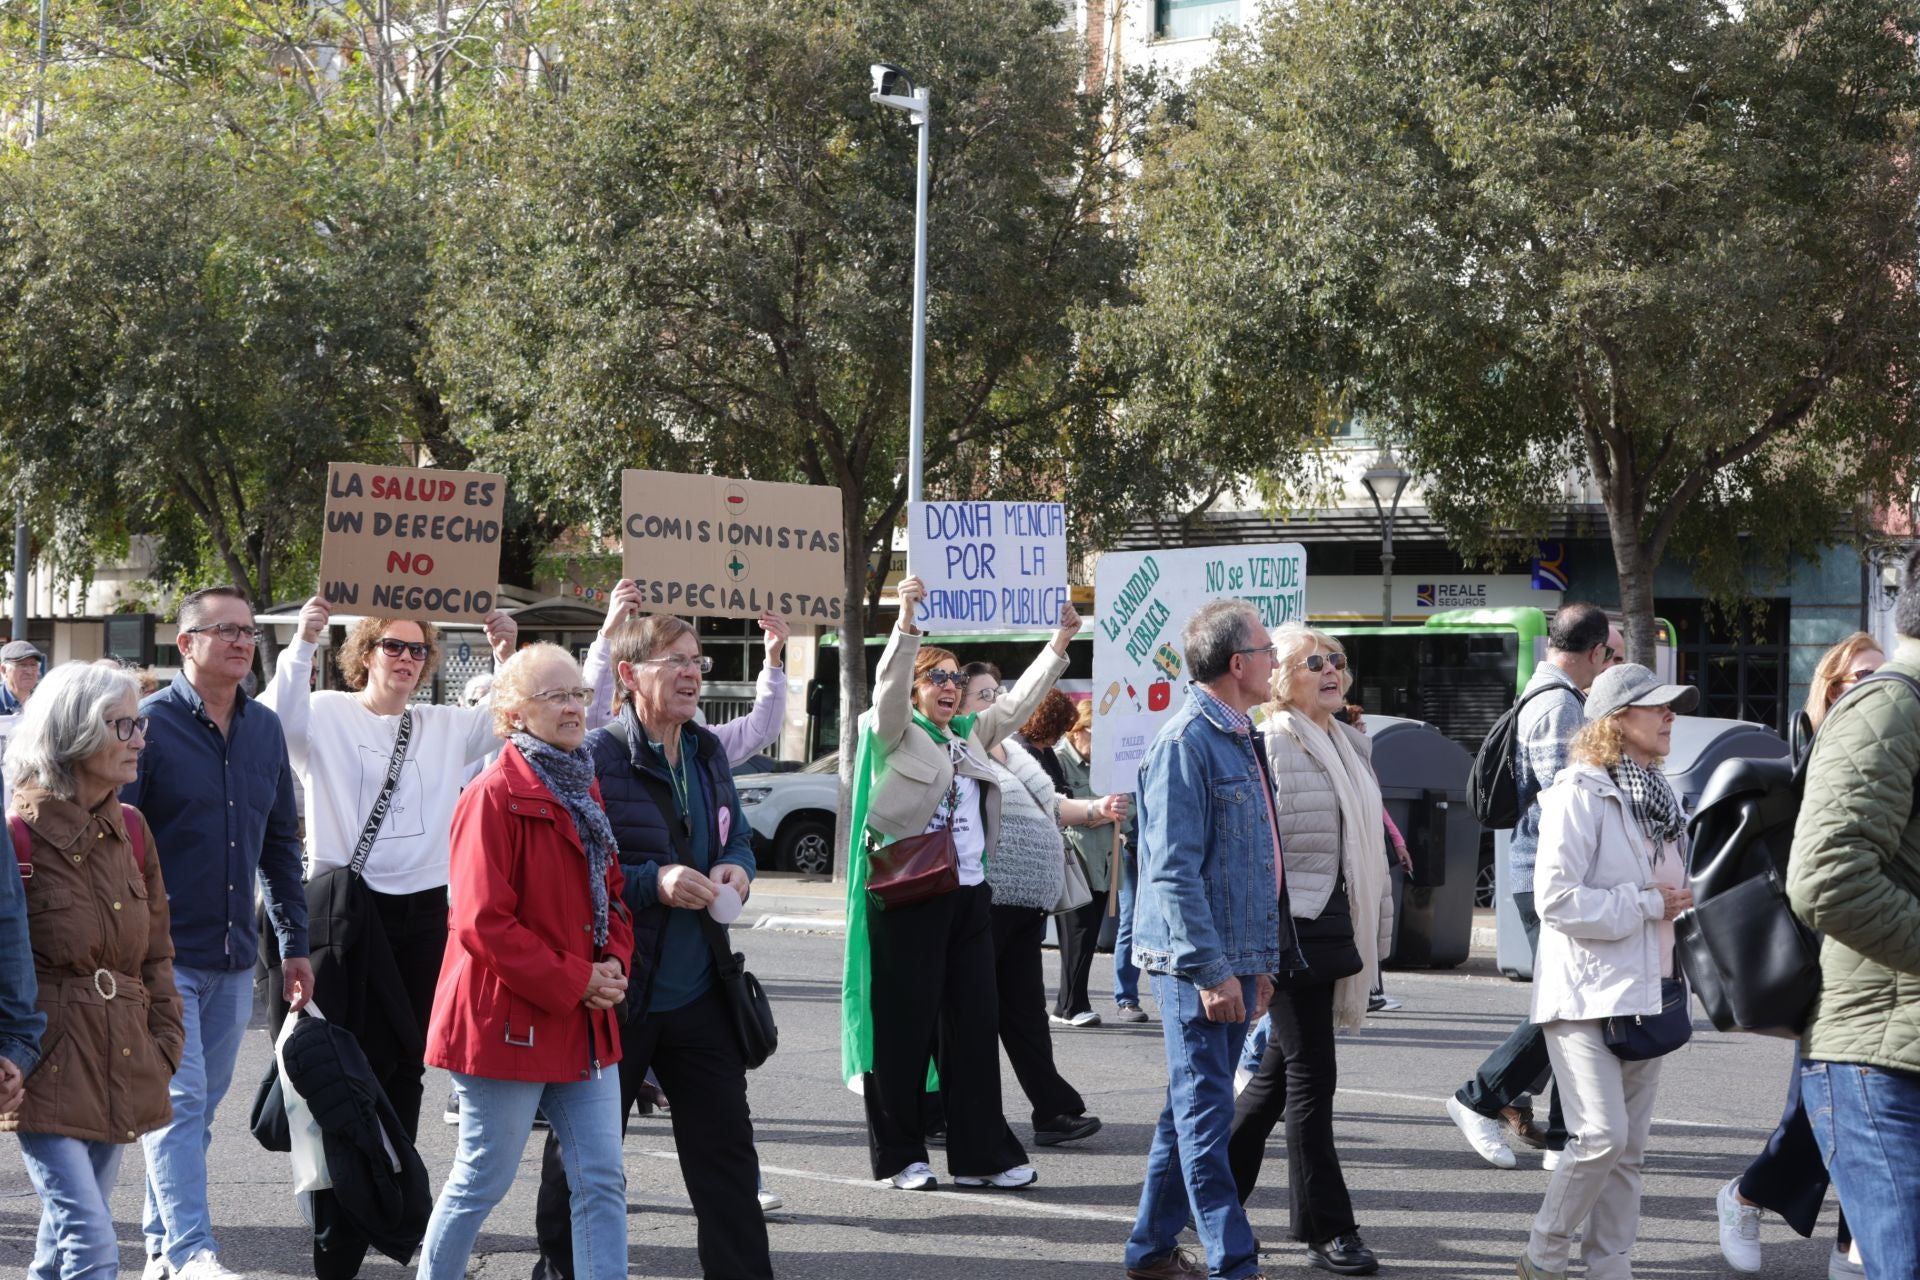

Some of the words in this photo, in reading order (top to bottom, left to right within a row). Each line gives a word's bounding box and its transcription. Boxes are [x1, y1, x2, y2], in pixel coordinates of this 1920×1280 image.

[331, 471, 363, 498] LA
[370, 475, 456, 501] SALUD
[464, 481, 496, 506] ES
[327, 511, 362, 534] UN
[373, 512, 499, 543] DERECHO
[626, 513, 840, 553] COMISIONISTAS
[926, 502, 991, 540] DOÑA
[1004, 503, 1062, 537] MENCIA
[386, 551, 434, 576] NO
[946, 543, 995, 580] POR
[1020, 546, 1045, 576] LA
[1205, 560, 1225, 593] NO
[1228, 565, 1243, 590] se
[1248, 557, 1299, 589] VENDE
[324, 581, 359, 605] UN
[372, 585, 492, 614] NEGOCIO
[635, 579, 841, 619] ESPECIALISTAS
[917, 589, 997, 622] SANIDAD
[1002, 587, 1067, 624] PUBLICA
[1100, 616, 1121, 643] La
[1113, 555, 1160, 626] SANIDAD
[1438, 584, 1486, 596] REALE
[1438, 598, 1486, 607] SEGUROS
[1125, 598, 1171, 667] PÚBLICA
[461, 646, 468, 660] 5
[1121, 735, 1144, 747] TALLER
